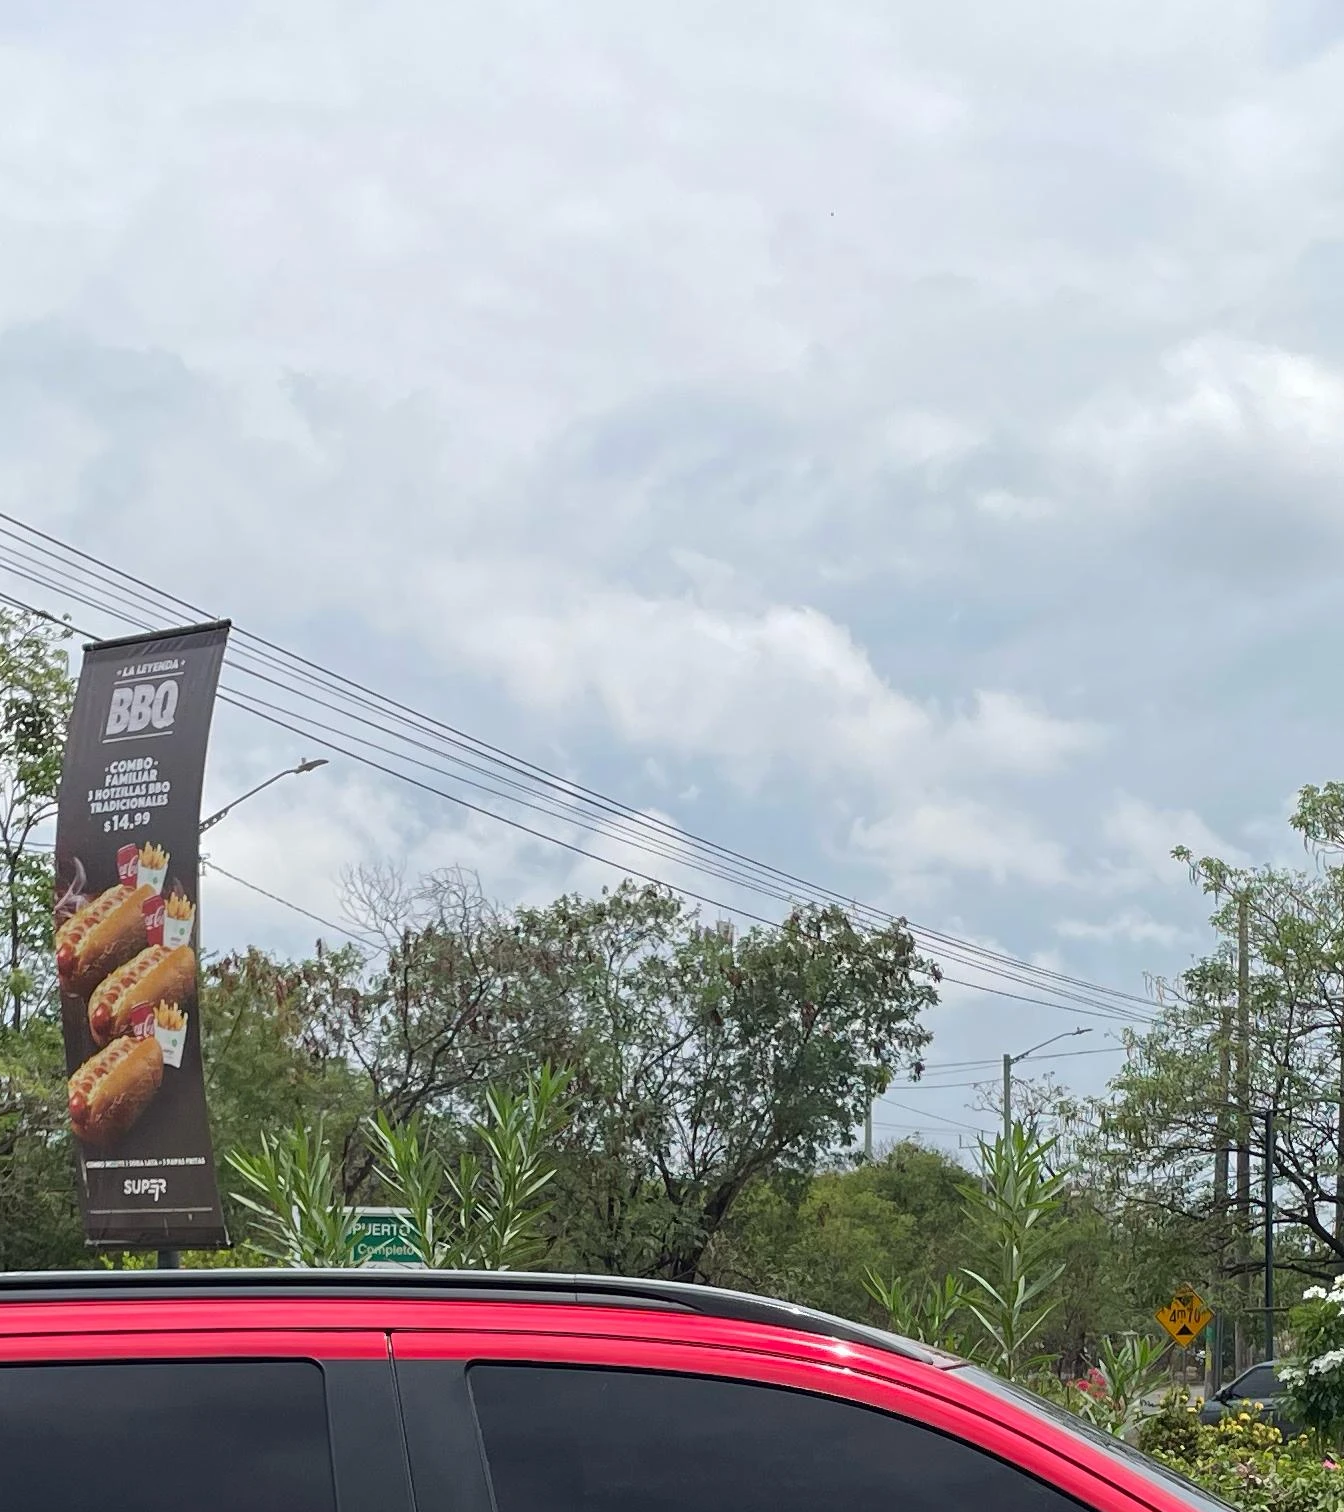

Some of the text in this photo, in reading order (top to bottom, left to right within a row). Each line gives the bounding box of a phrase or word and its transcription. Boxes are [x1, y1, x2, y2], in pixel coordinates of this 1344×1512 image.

[122, 659, 178, 677] LA LEYENDA
[106, 680, 179, 735] BBQ
[110, 757, 153, 773] COMBO
[105, 769, 157, 787] FAMILIAR
[91, 794, 168, 814] TRADICIONALES
[104, 812, 150, 832] $14.99
